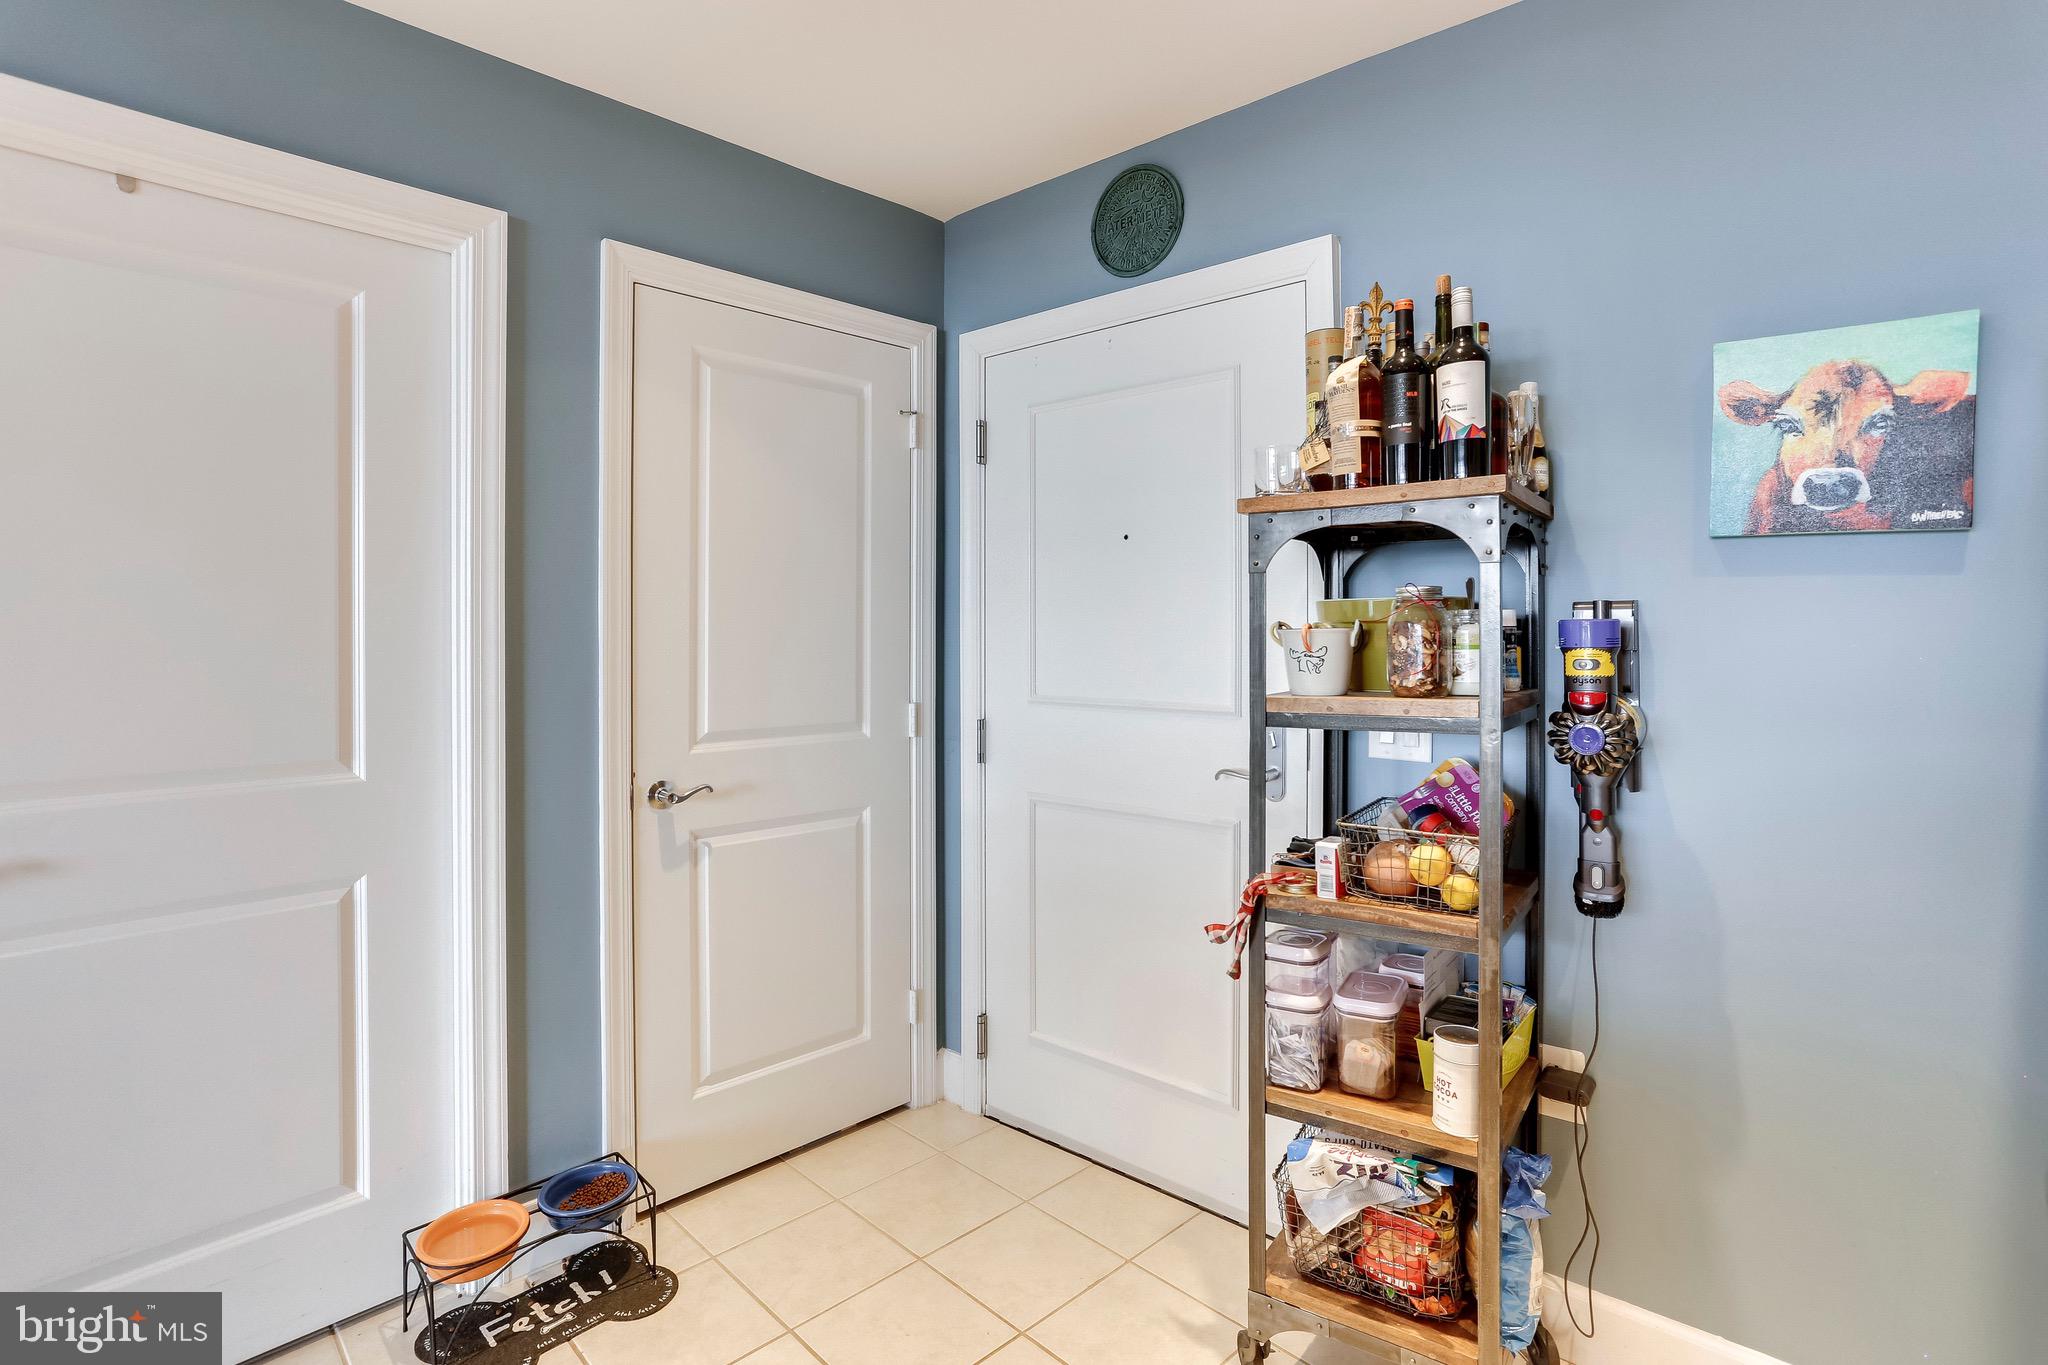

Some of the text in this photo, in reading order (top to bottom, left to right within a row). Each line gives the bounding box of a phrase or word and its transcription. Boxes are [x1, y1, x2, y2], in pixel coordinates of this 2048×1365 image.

[1572, 677, 1602, 686] dyson
[1444, 793, 1471, 823] Company
[1450, 788, 1473, 812] Little
[1436, 1076, 1452, 1089] HOT
[478, 1269, 618, 1348] Fetch!
